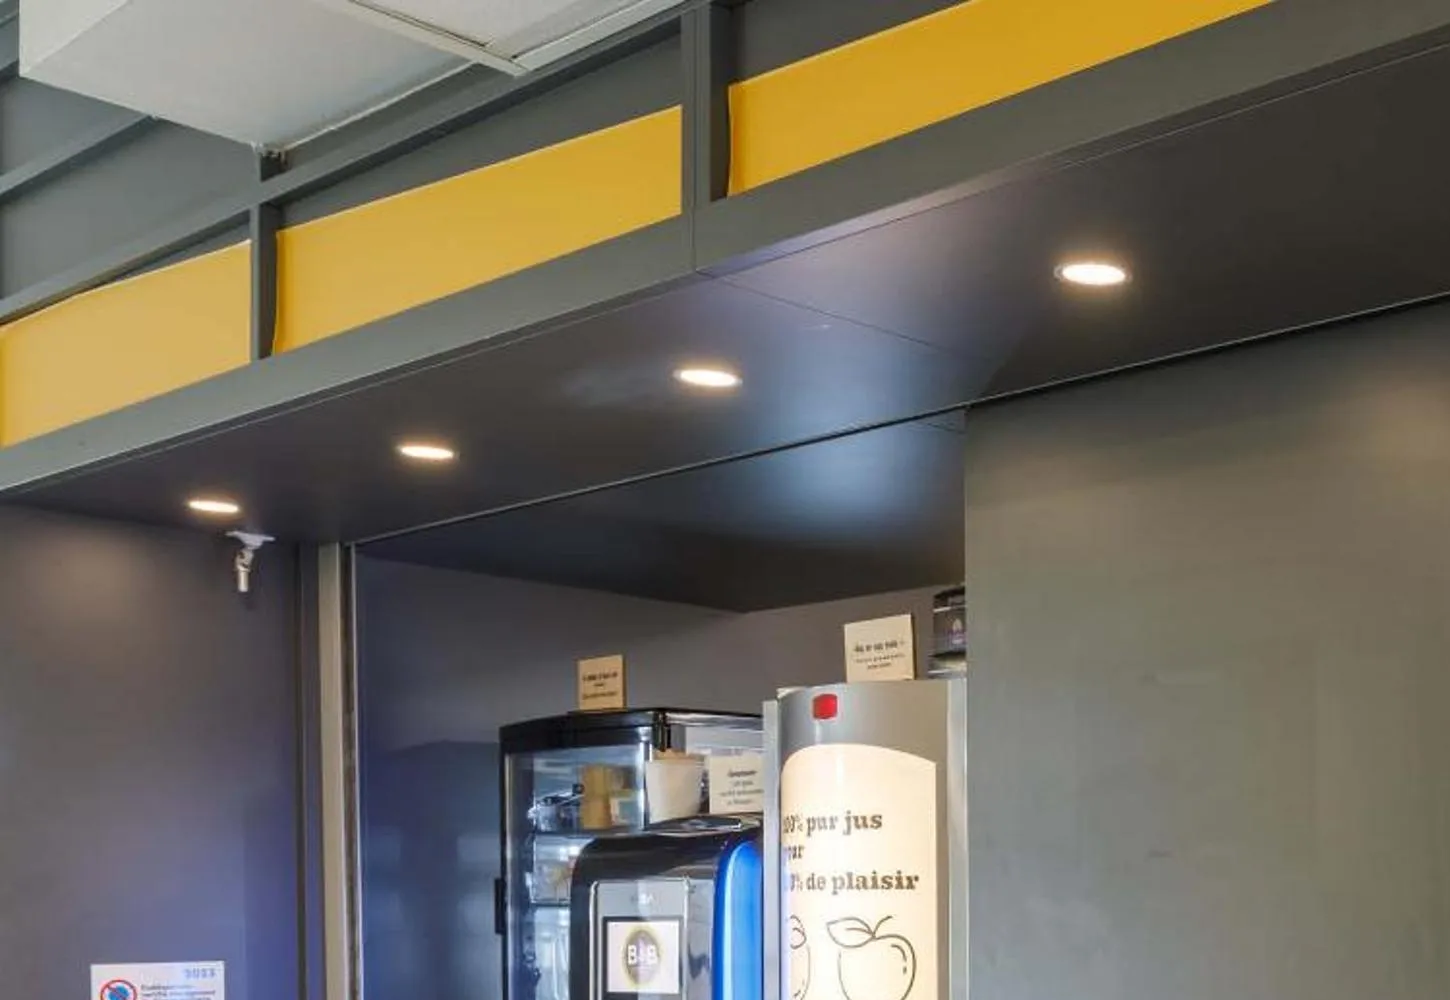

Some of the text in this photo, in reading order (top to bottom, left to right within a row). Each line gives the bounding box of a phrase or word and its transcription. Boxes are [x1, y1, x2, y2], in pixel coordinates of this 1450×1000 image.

[806, 815, 839, 838] pur
[842, 809, 883, 836] jus
[805, 872, 827, 891] de
[831, 869, 920, 896] plaisir
